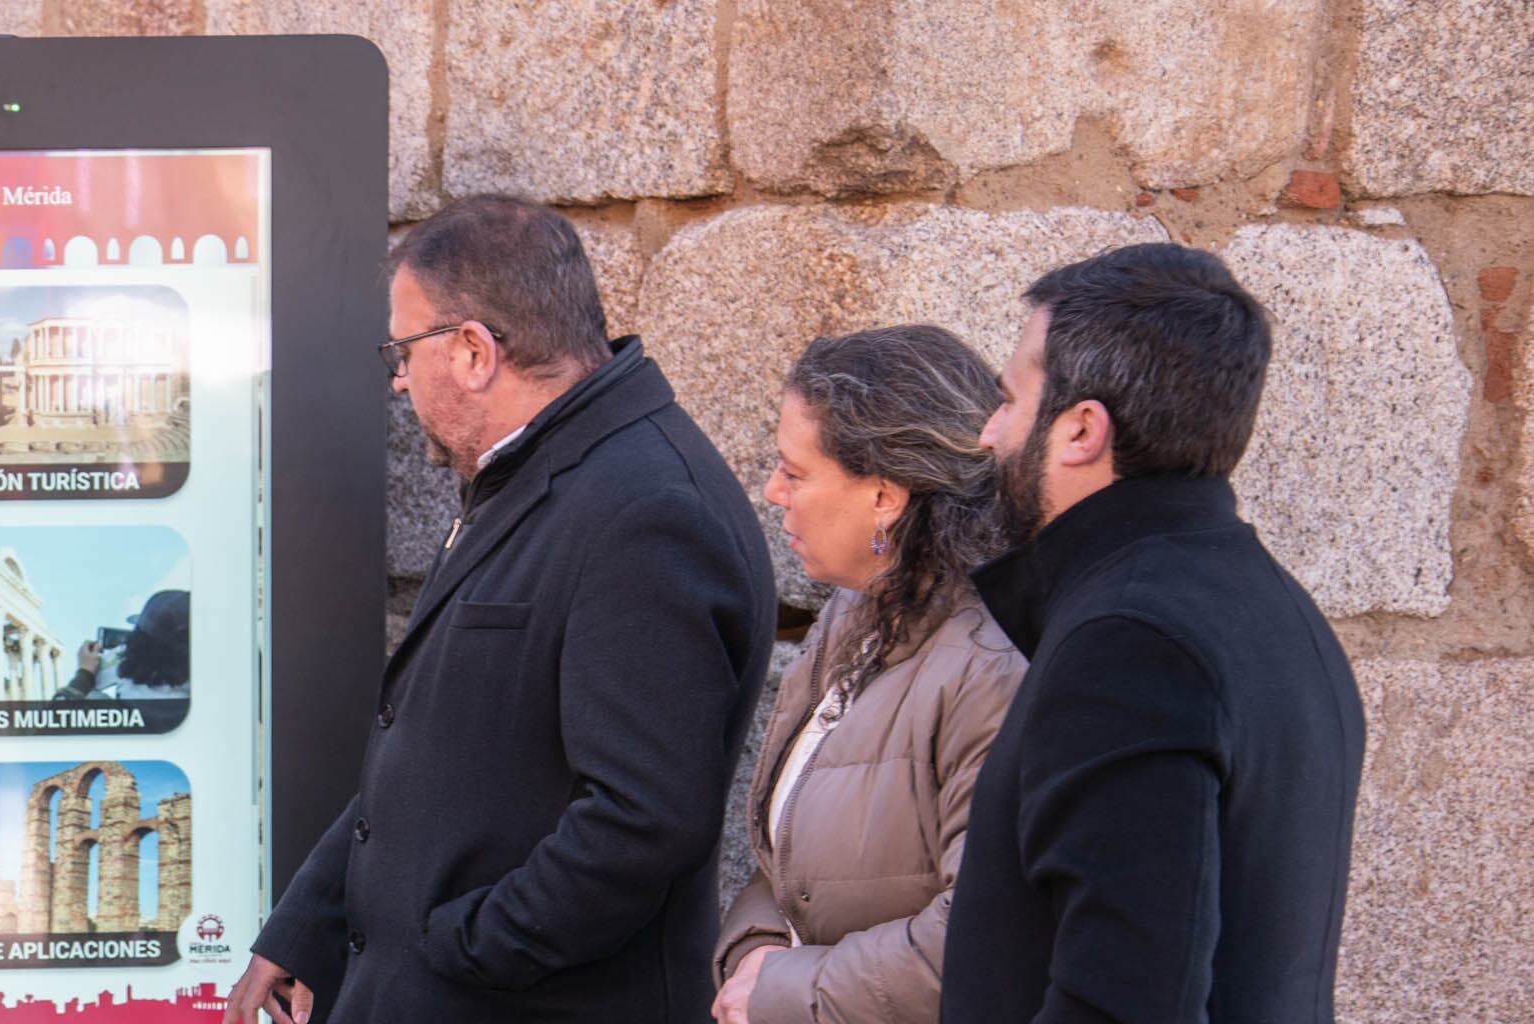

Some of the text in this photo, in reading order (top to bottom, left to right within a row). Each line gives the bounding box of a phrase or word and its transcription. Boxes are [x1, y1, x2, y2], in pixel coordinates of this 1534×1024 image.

[1, 185, 73, 205] Mérida
[28, 468, 140, 491] TURÍSTICA
[14, 709, 145, 728] MULTIMEDIA
[8, 940, 161, 960] APLICACIONES
